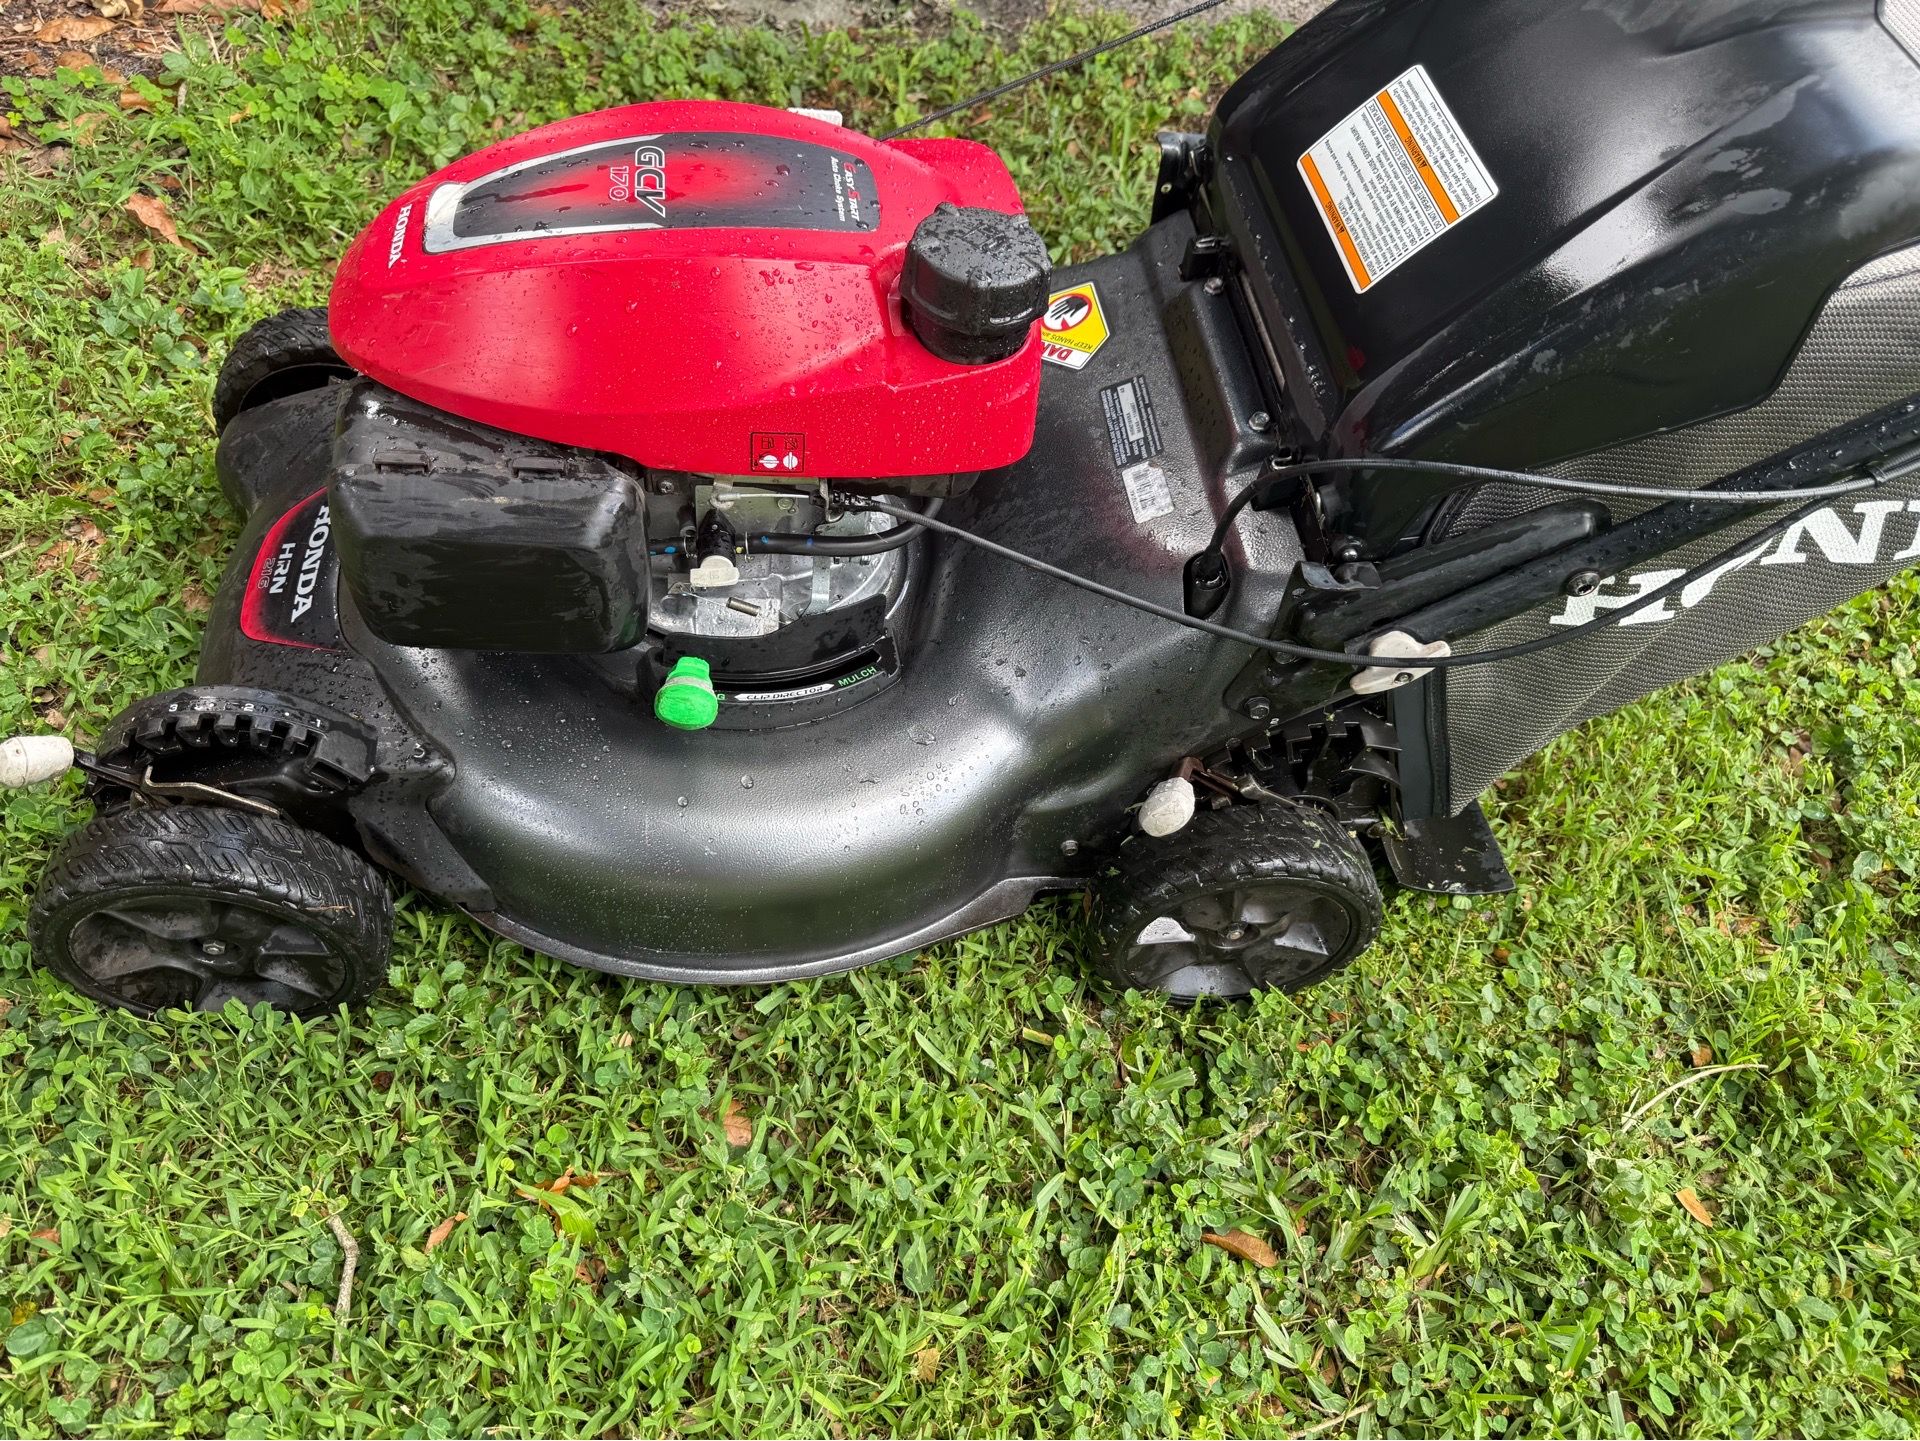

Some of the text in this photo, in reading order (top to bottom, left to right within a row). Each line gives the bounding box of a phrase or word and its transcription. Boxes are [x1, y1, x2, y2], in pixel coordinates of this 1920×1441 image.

[1357, 139, 1371, 160] SERIOUS
[1403, 135, 1423, 164] WARNING
[1367, 158, 1379, 175] CAUSE
[609, 165, 628, 202] 170
[634, 146, 666, 218] GCV
[830, 156, 846, 221] Auto Choke System
[1374, 172, 1384, 185] CAN
[1380, 182, 1392, 200] BLADE
[1388, 197, 1396, 207] BY
[848, 189, 860, 221] START
[1324, 200, 1341, 228] WARNING
[1392, 204, 1407, 227] THROWN
[388, 204, 412, 268] HONDA
[1402, 225, 1418, 247] OBJECT
[1050, 333, 1070, 346] HANDS
[1070, 336, 1093, 350] KEEP
[1041, 341, 1073, 361] DAN
[258, 558, 276, 589] 216
[269, 543, 296, 594] HRN
[291, 506, 331, 623] HONDA
[838, 666, 877, 687] MULCH
[772, 686, 823, 700] DIRECTOR
[168, 704, 178, 712] 3
[244, 704, 254, 712] 2
